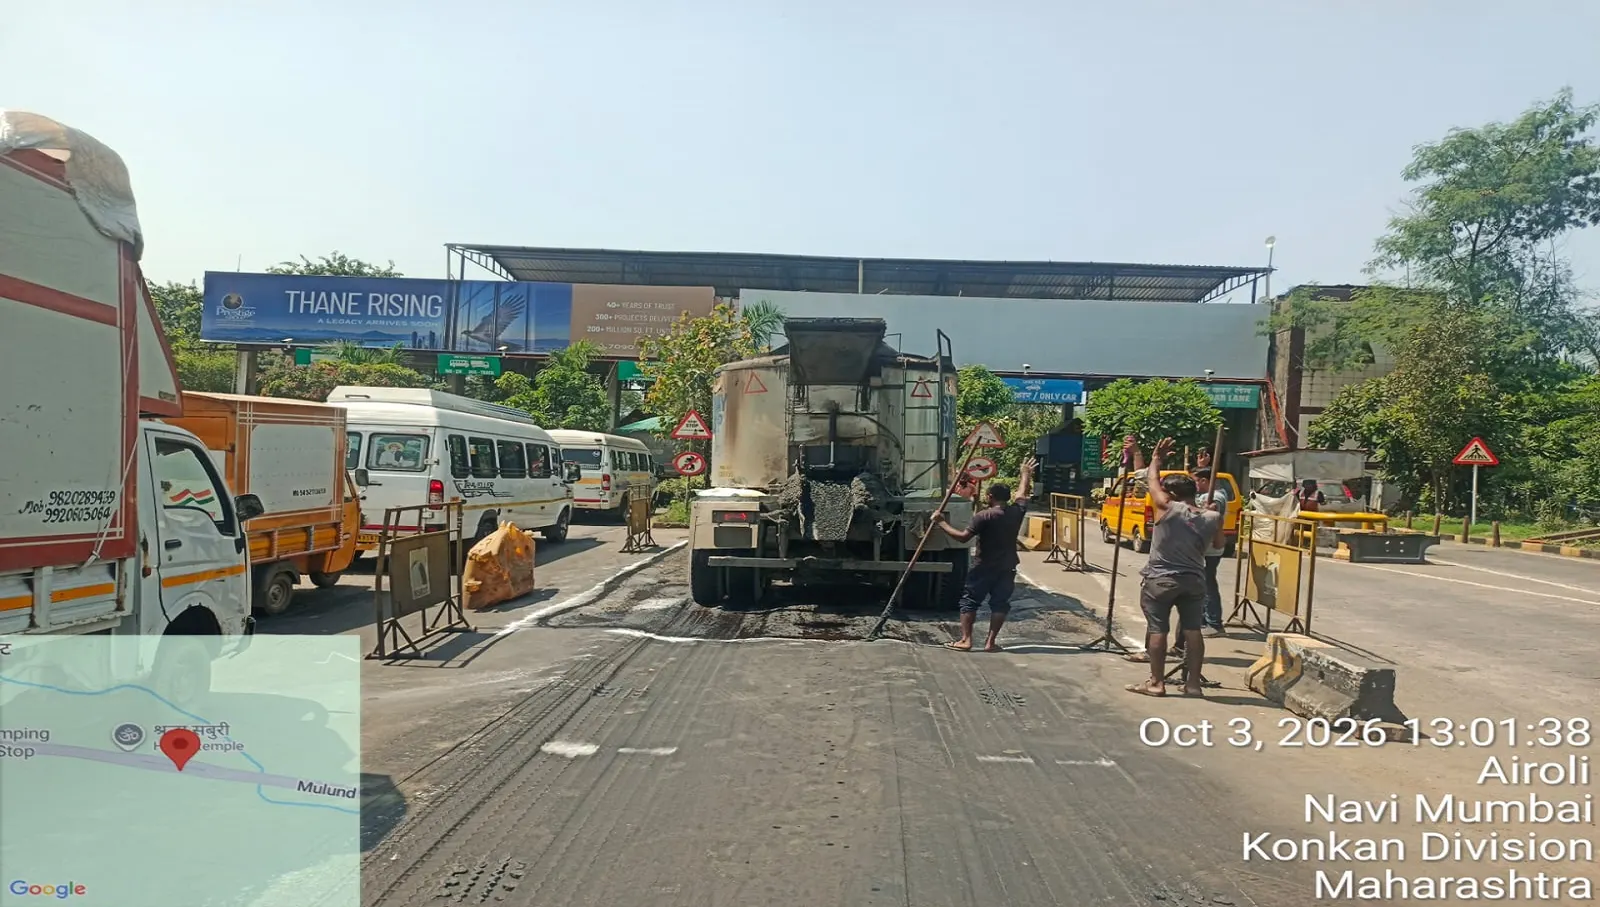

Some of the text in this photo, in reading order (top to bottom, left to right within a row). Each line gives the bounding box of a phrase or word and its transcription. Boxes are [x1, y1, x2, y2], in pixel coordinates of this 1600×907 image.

[285, 290, 443, 318] THANE RISING
[1062, 393, 1077, 401] CAR
